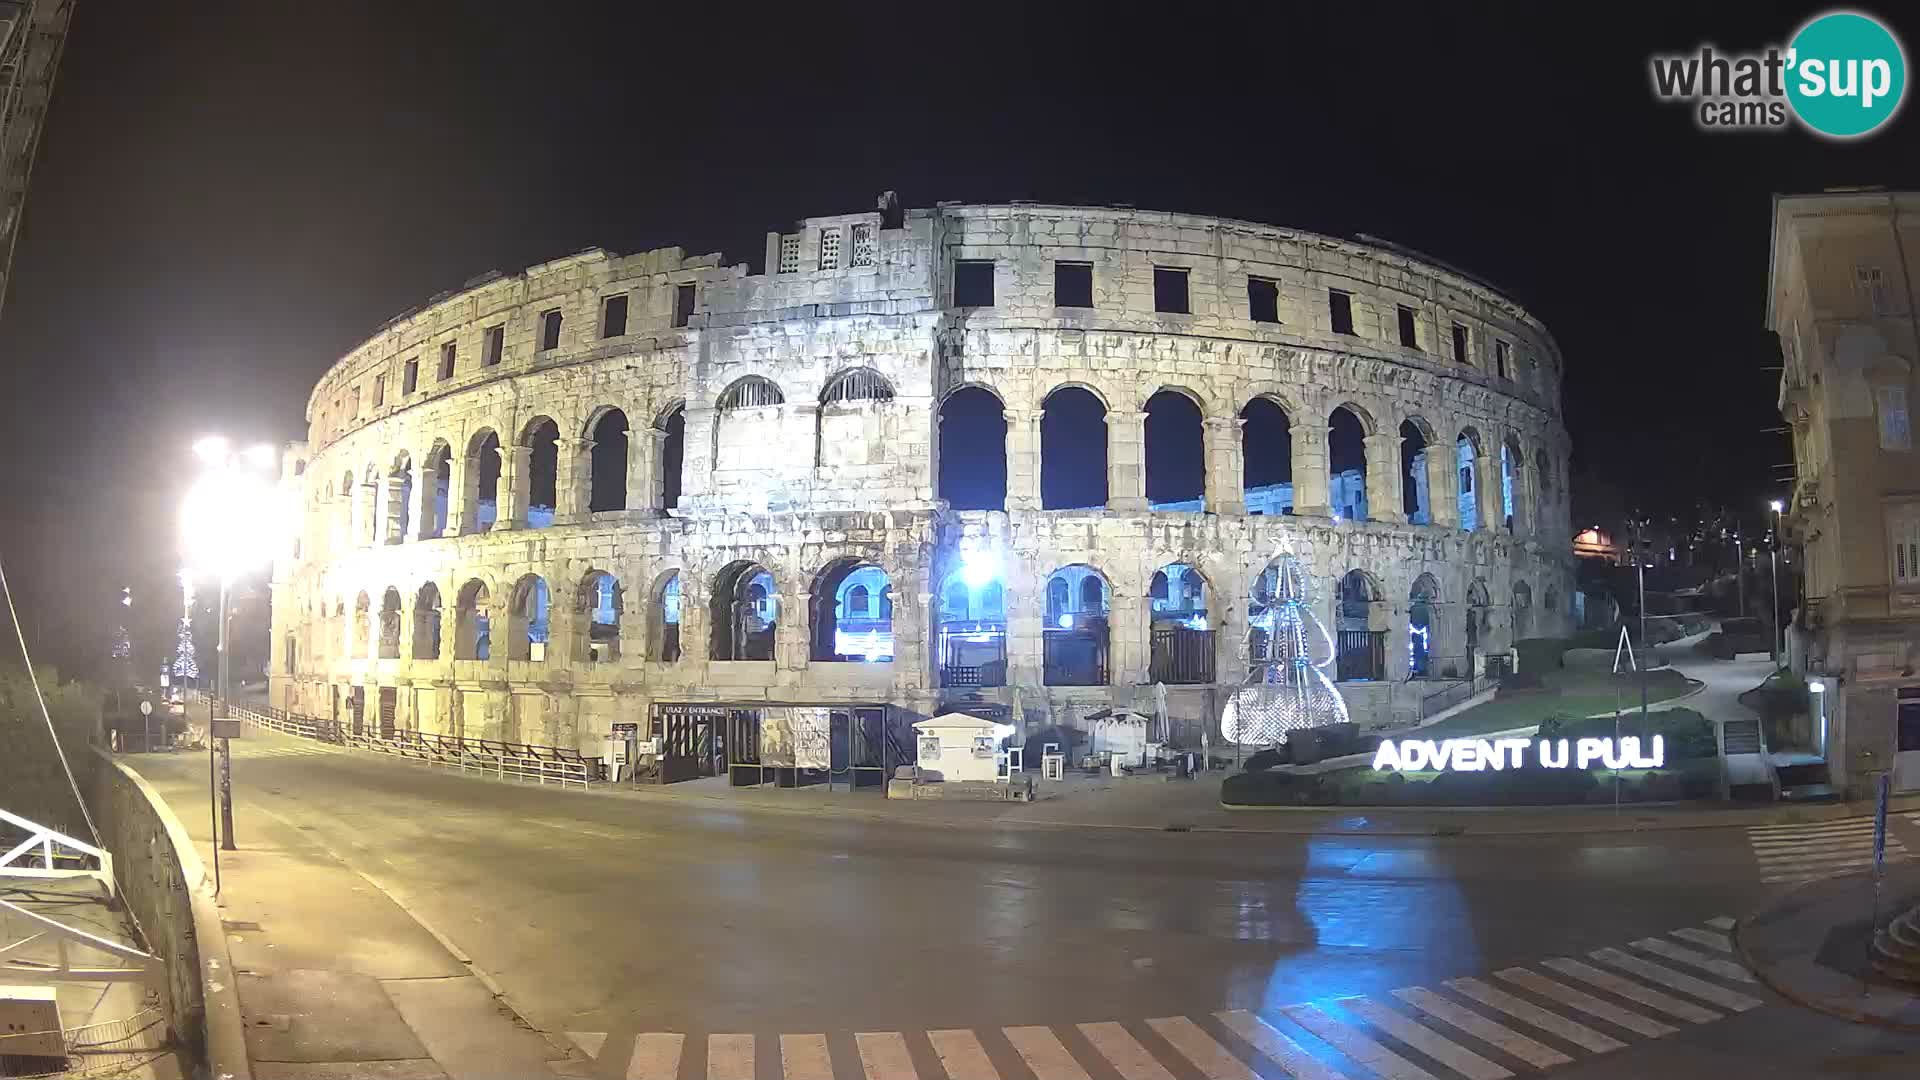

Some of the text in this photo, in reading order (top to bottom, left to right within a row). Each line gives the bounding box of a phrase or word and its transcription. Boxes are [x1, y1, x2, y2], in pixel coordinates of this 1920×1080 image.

[688, 706, 724, 715] ENTRANCE
[1372, 735, 1665, 771] ADVENT U PULI
